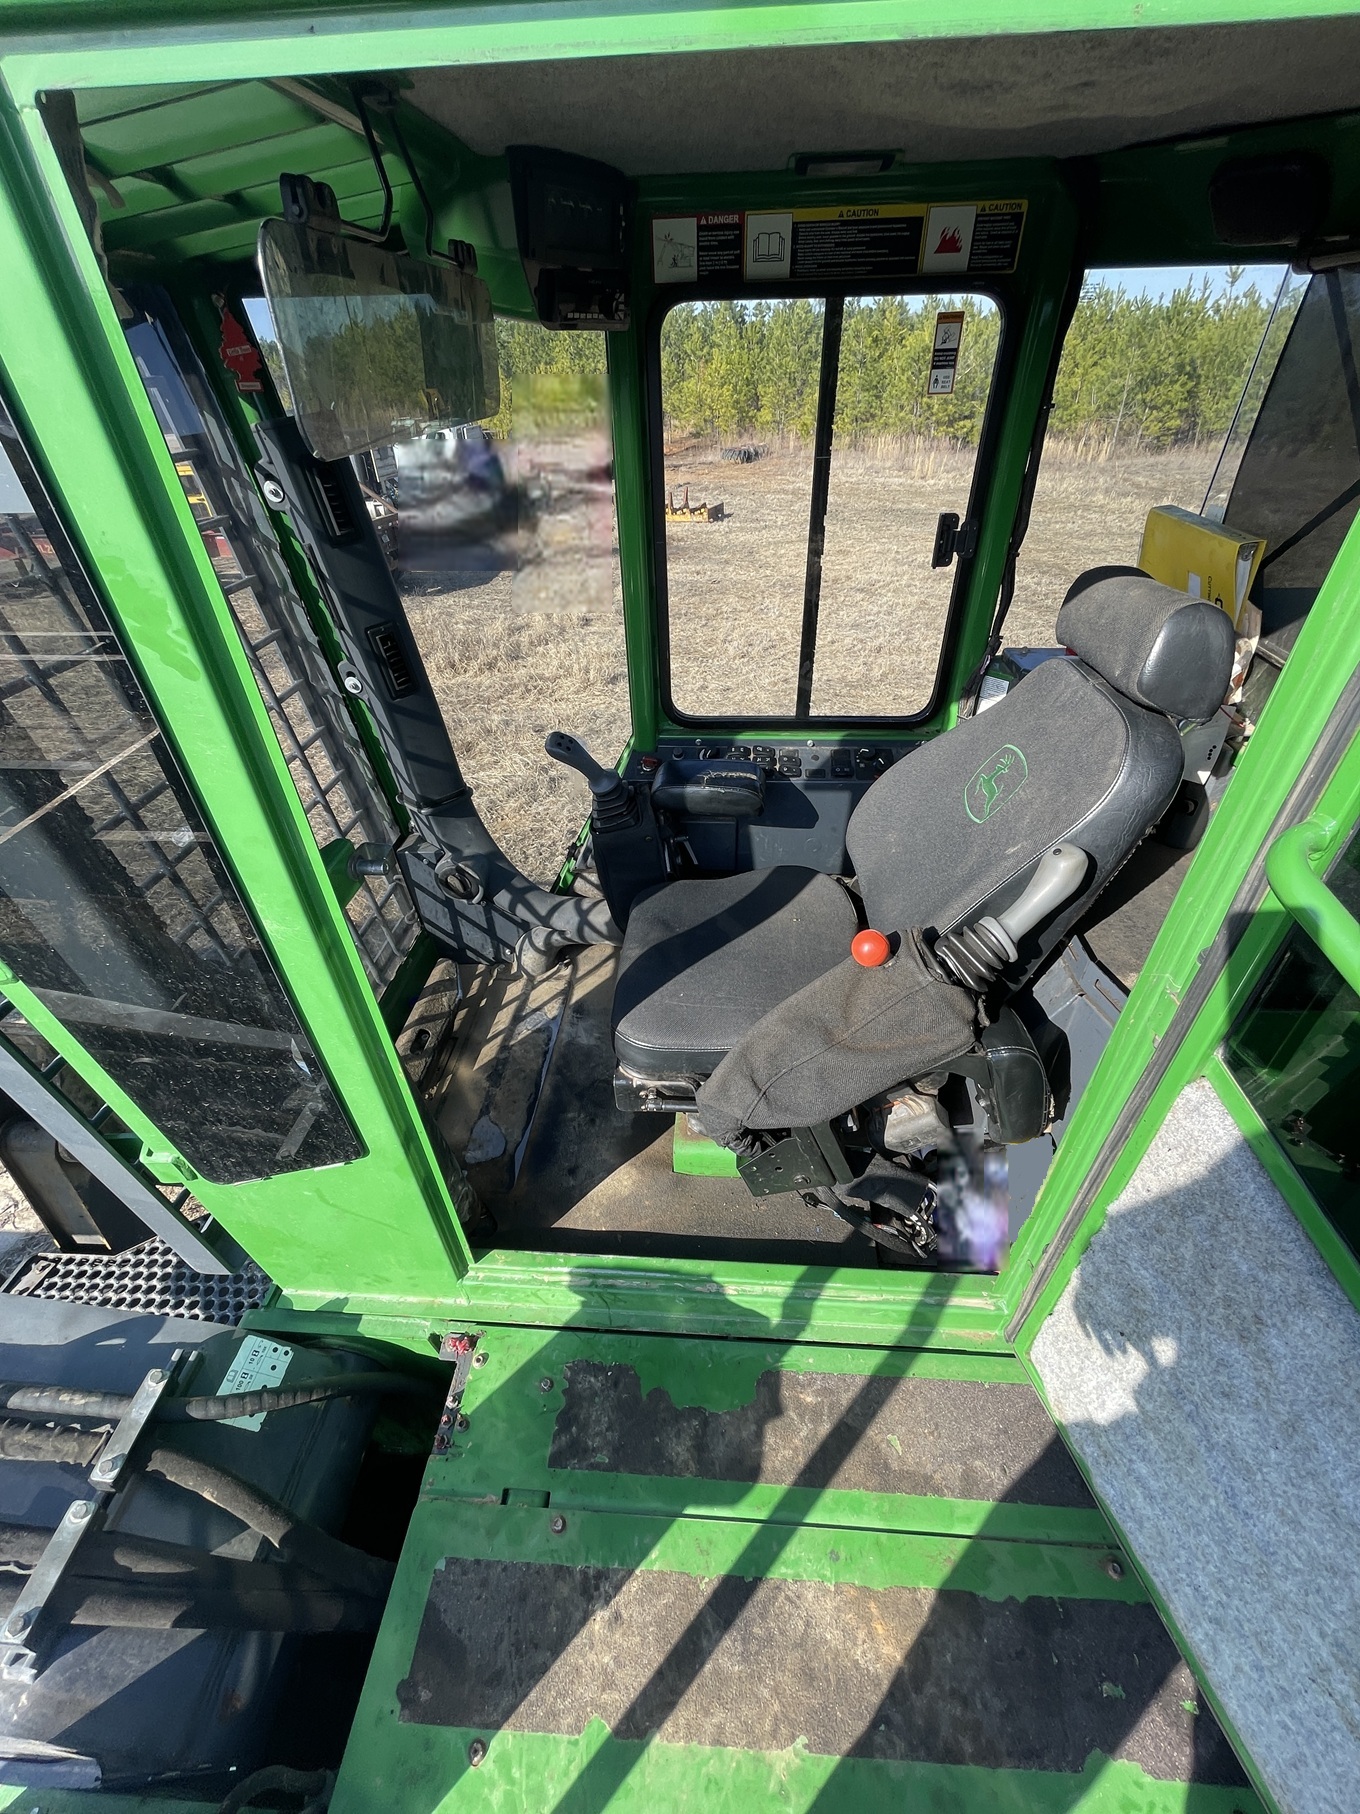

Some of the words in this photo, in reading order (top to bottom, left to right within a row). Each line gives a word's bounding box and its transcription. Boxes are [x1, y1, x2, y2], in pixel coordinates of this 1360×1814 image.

[989, 203, 1023, 212] CAUTION
[846, 208, 880, 218] CAUTION
[708, 214, 739, 224] DANGER
[236, 1380, 244, 1391] 100
